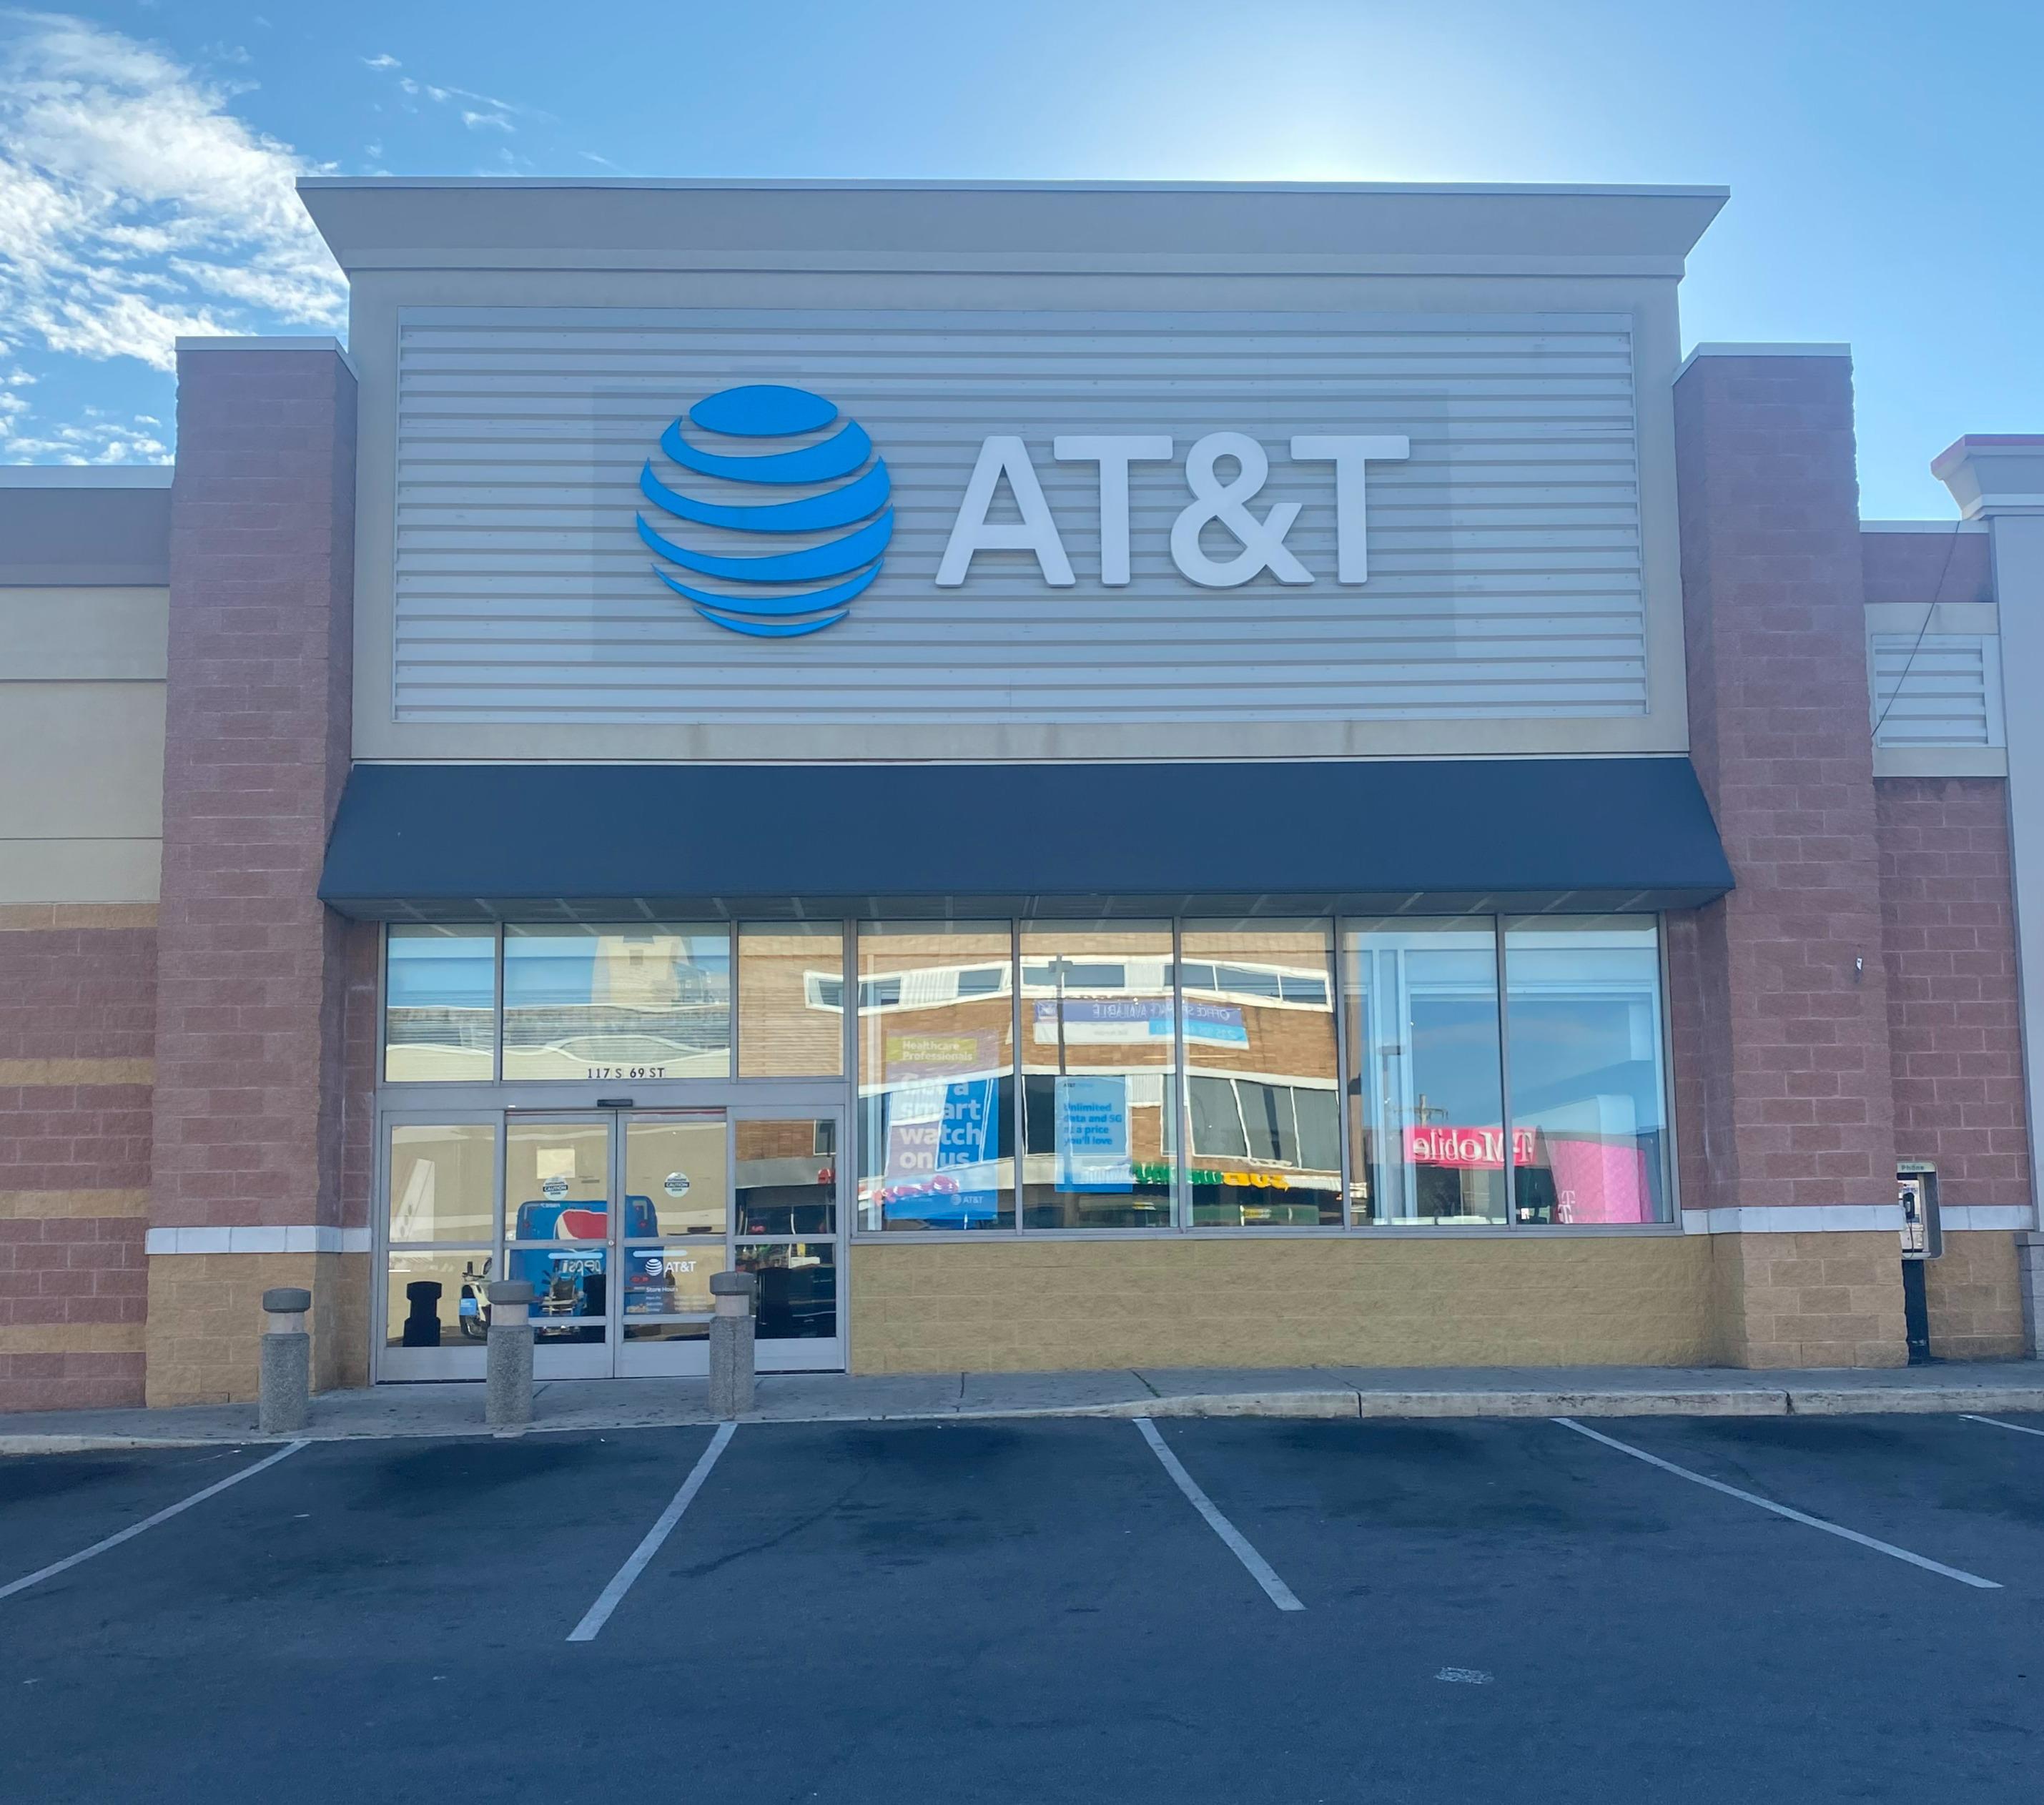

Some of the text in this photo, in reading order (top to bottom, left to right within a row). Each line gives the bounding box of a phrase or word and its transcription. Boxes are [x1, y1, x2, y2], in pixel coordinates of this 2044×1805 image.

[935, 431, 1410, 589] AT&T
[903, 1040, 959, 1050] Healthcare
[903, 1052, 972, 1061] Professionals
[588, 1067, 664, 1078] 117 S 69 ST
[953, 1079, 969, 1095] a
[902, 1099, 980, 1120] smart
[1064, 1103, 1112, 1112] Unlimited
[1064, 1114, 1086, 1122] data
[1109, 1114, 1122, 1123] 5G
[899, 1122, 982, 1145] watch
[1085, 1125, 1108, 1136] price
[1064, 1137, 1090, 1147] you'll
[899, 1152, 969, 1169] on us
[664, 1261, 696, 1272] AT&T
